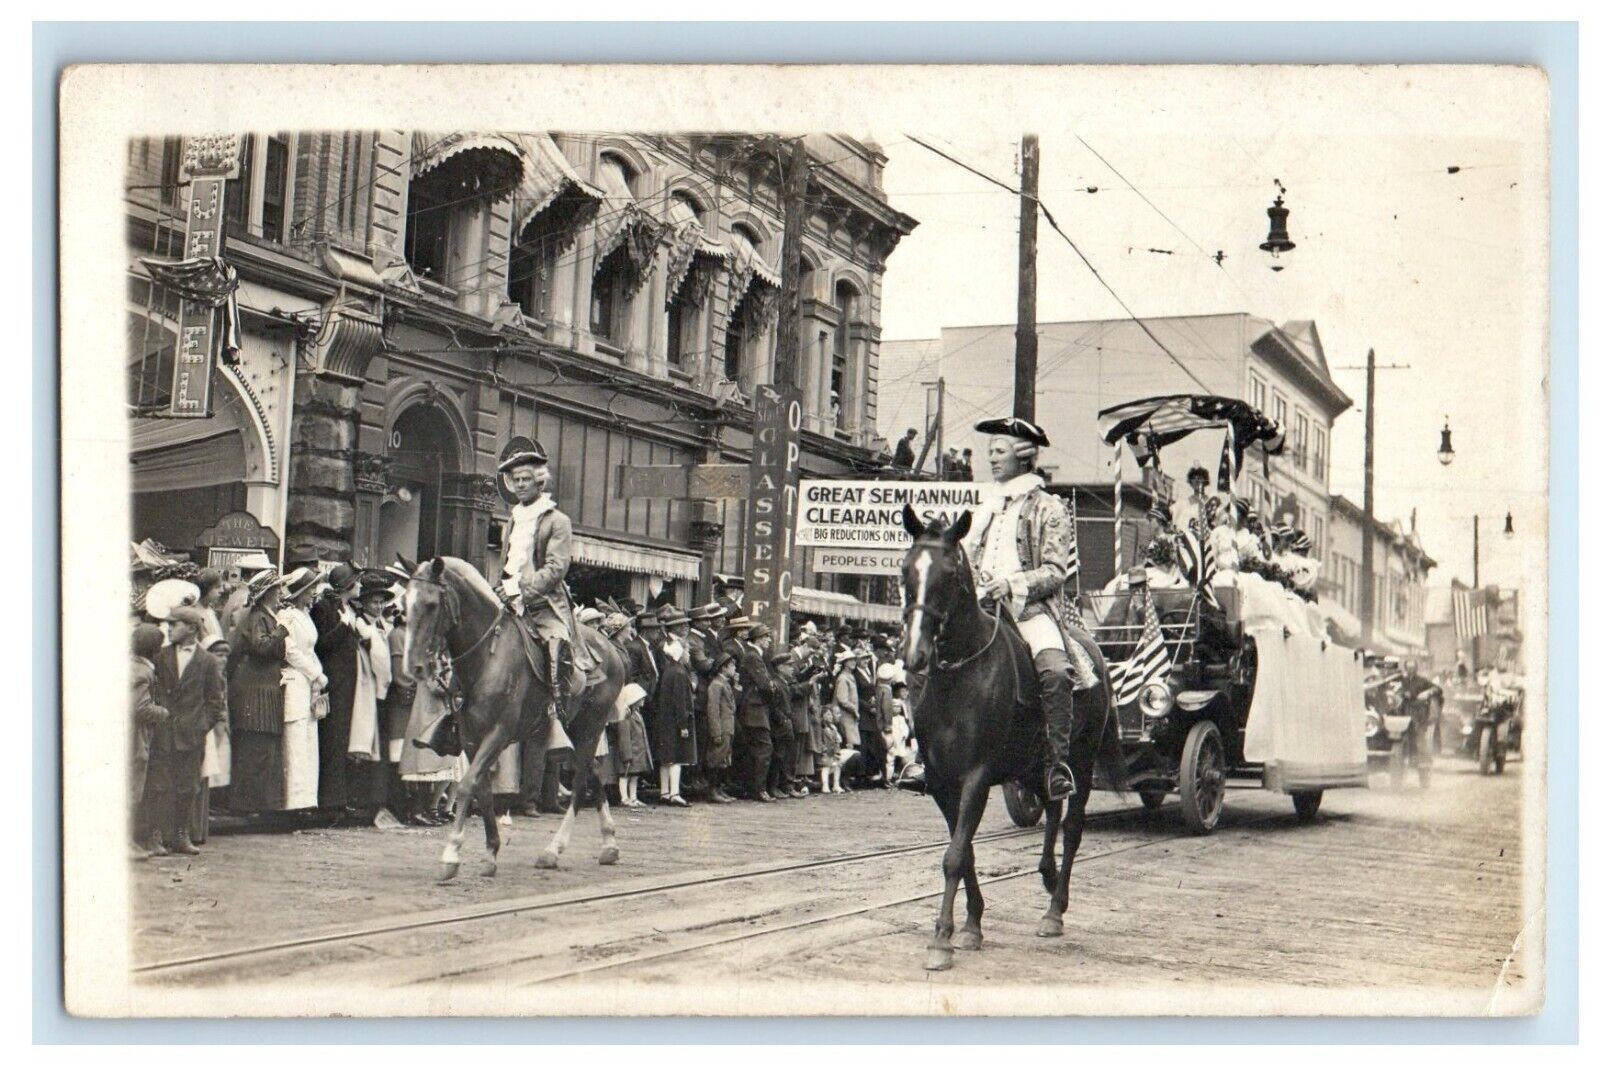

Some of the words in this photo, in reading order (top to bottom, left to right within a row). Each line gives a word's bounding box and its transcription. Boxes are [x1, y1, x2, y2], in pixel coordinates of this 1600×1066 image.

[179, 183, 217, 410] JEEL
[807, 486, 865, 503] GREAT
[751, 427, 778, 584] GLASSES
[806, 507, 904, 526] CLEARANC
[203, 534, 276, 549] JEWEL
[814, 528, 828, 541] BIG
[830, 530, 881, 543] REDUCTIONS
[883, 532, 896, 543] ON
